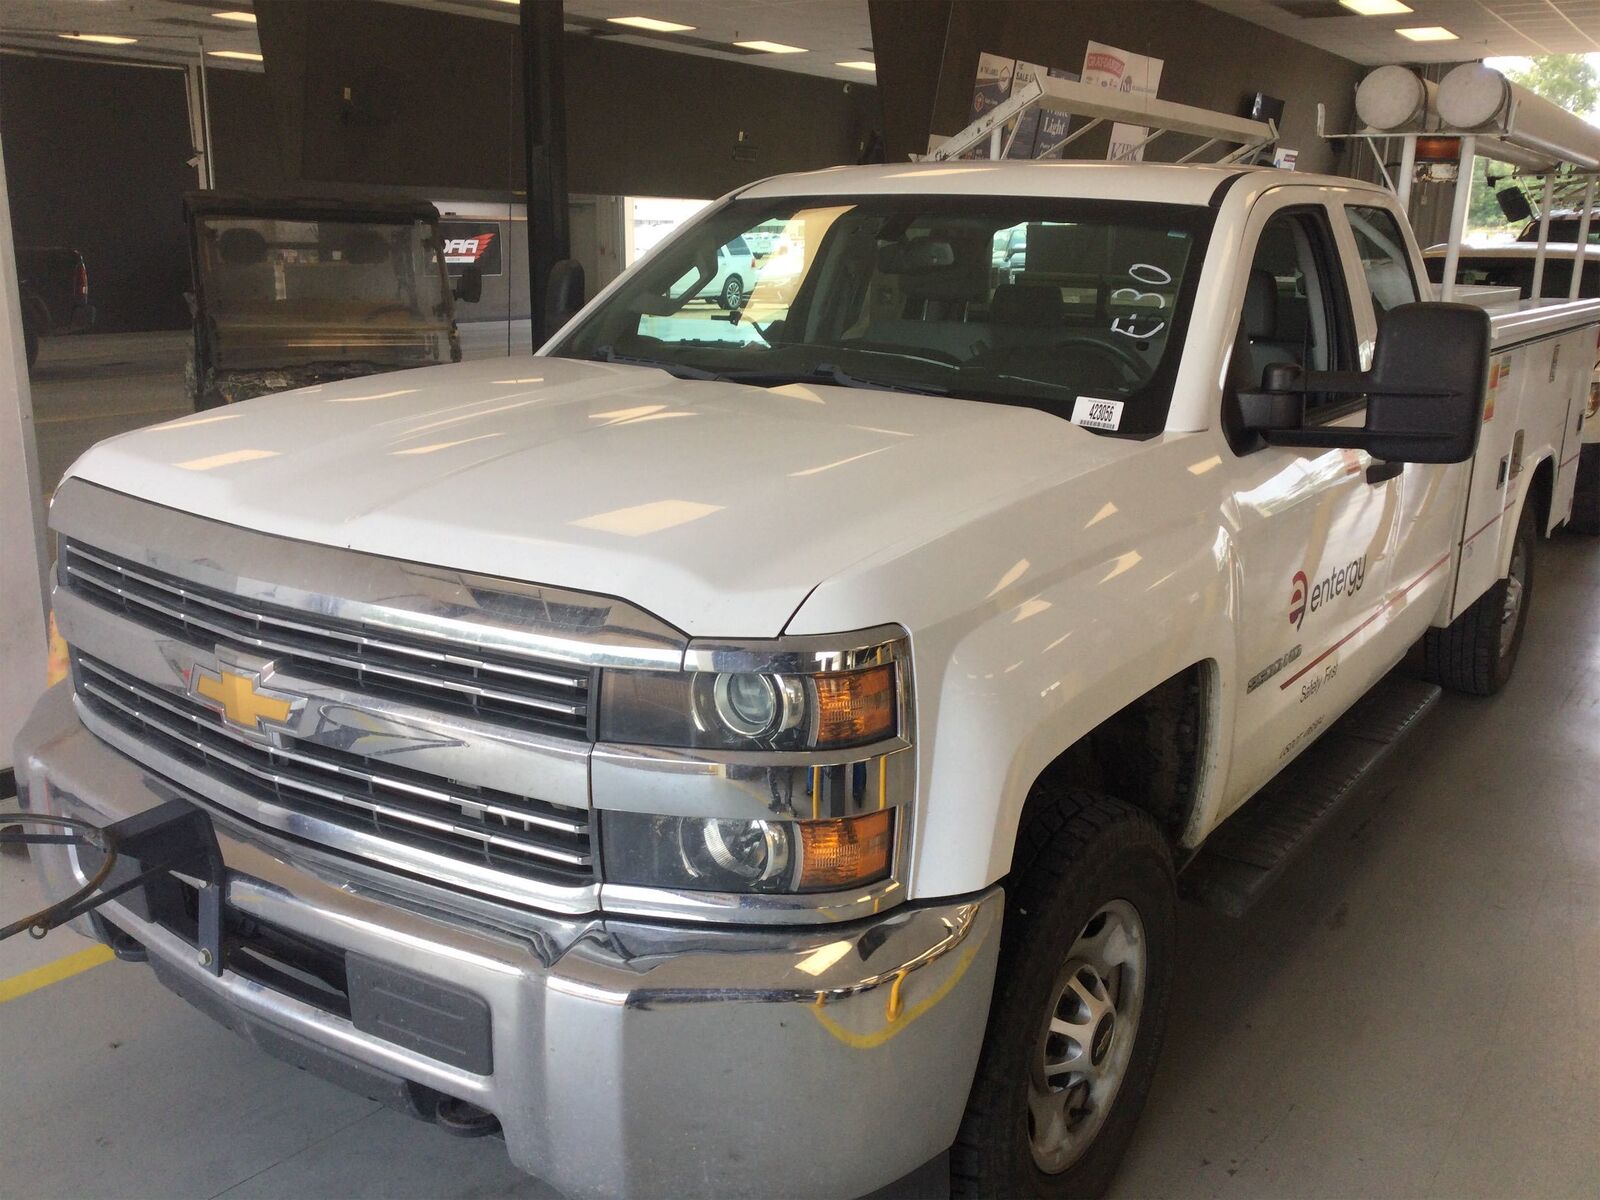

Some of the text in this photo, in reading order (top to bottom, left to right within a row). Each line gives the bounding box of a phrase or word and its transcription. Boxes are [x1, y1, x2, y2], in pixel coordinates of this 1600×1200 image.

[1043, 117, 1065, 136] Light
[1088, 403, 1115, 422] 423056
[1311, 554, 1367, 612] entergy
[1300, 676, 1322, 703] Safety
[1323, 663, 1338, 684] First
